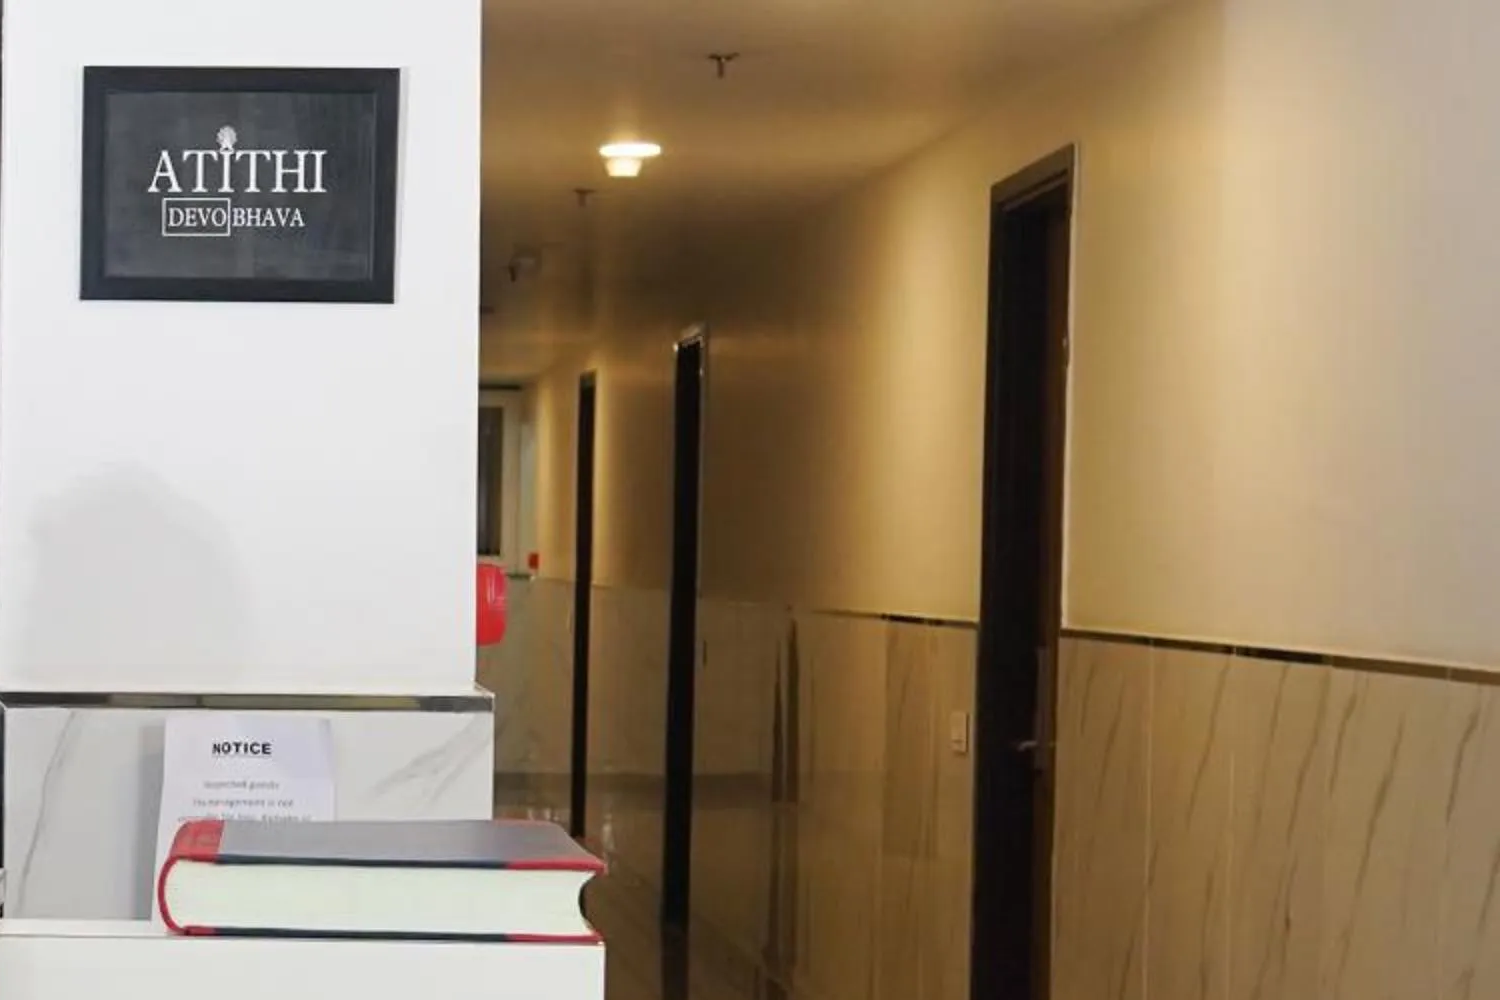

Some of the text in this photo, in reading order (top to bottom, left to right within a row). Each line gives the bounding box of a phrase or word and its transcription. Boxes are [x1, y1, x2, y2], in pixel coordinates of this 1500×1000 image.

[147, 149, 328, 193] ATITHI
[167, 207, 306, 228] DEVO BHAVA
[212, 742, 272, 755] NOTICE
